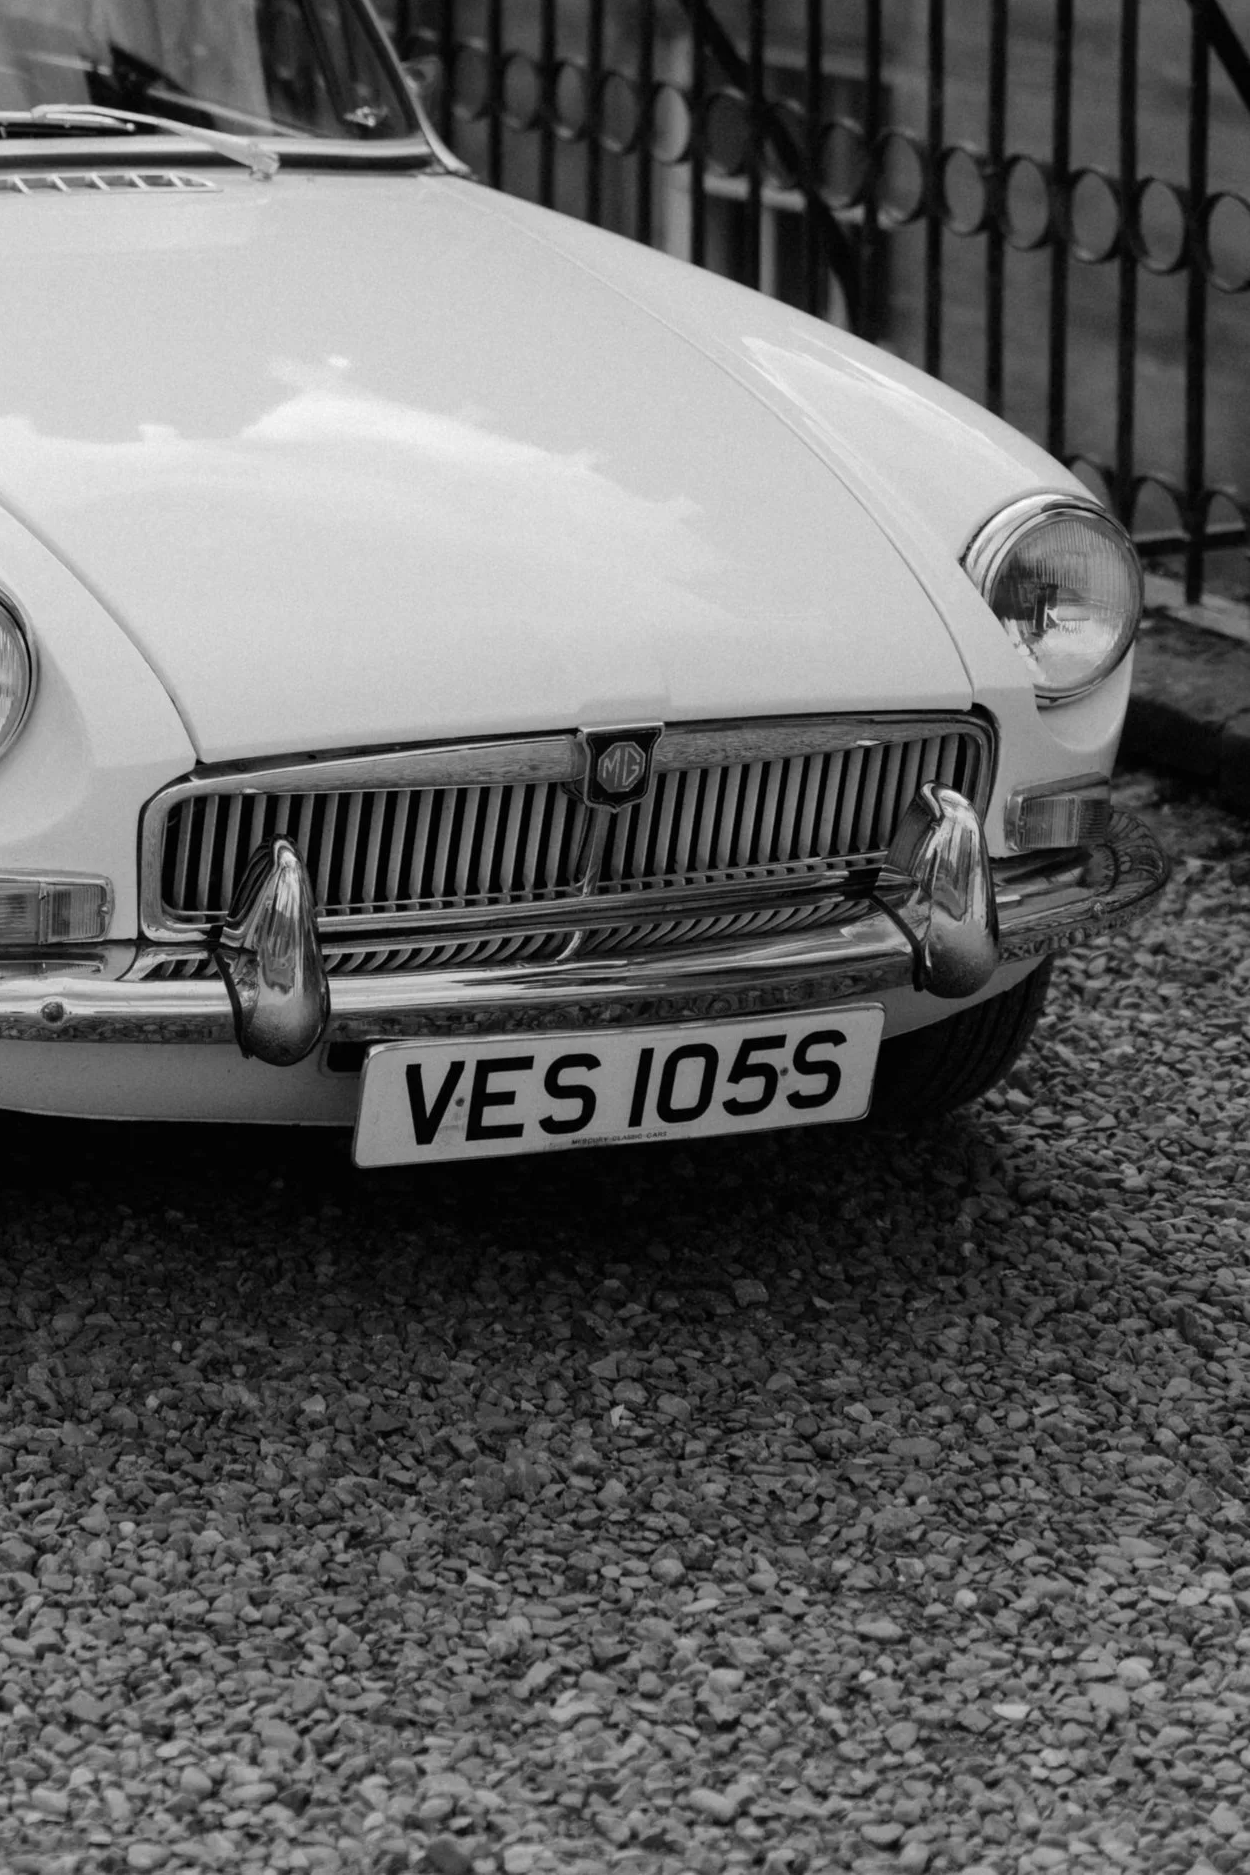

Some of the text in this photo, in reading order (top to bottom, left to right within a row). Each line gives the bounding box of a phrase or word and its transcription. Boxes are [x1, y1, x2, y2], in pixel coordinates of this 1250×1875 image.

[602, 746, 641, 788] MG
[405, 1029, 848, 1146] VES 105S
[571, 1131, 667, 1145] MERCURY CLASSIC CARS
